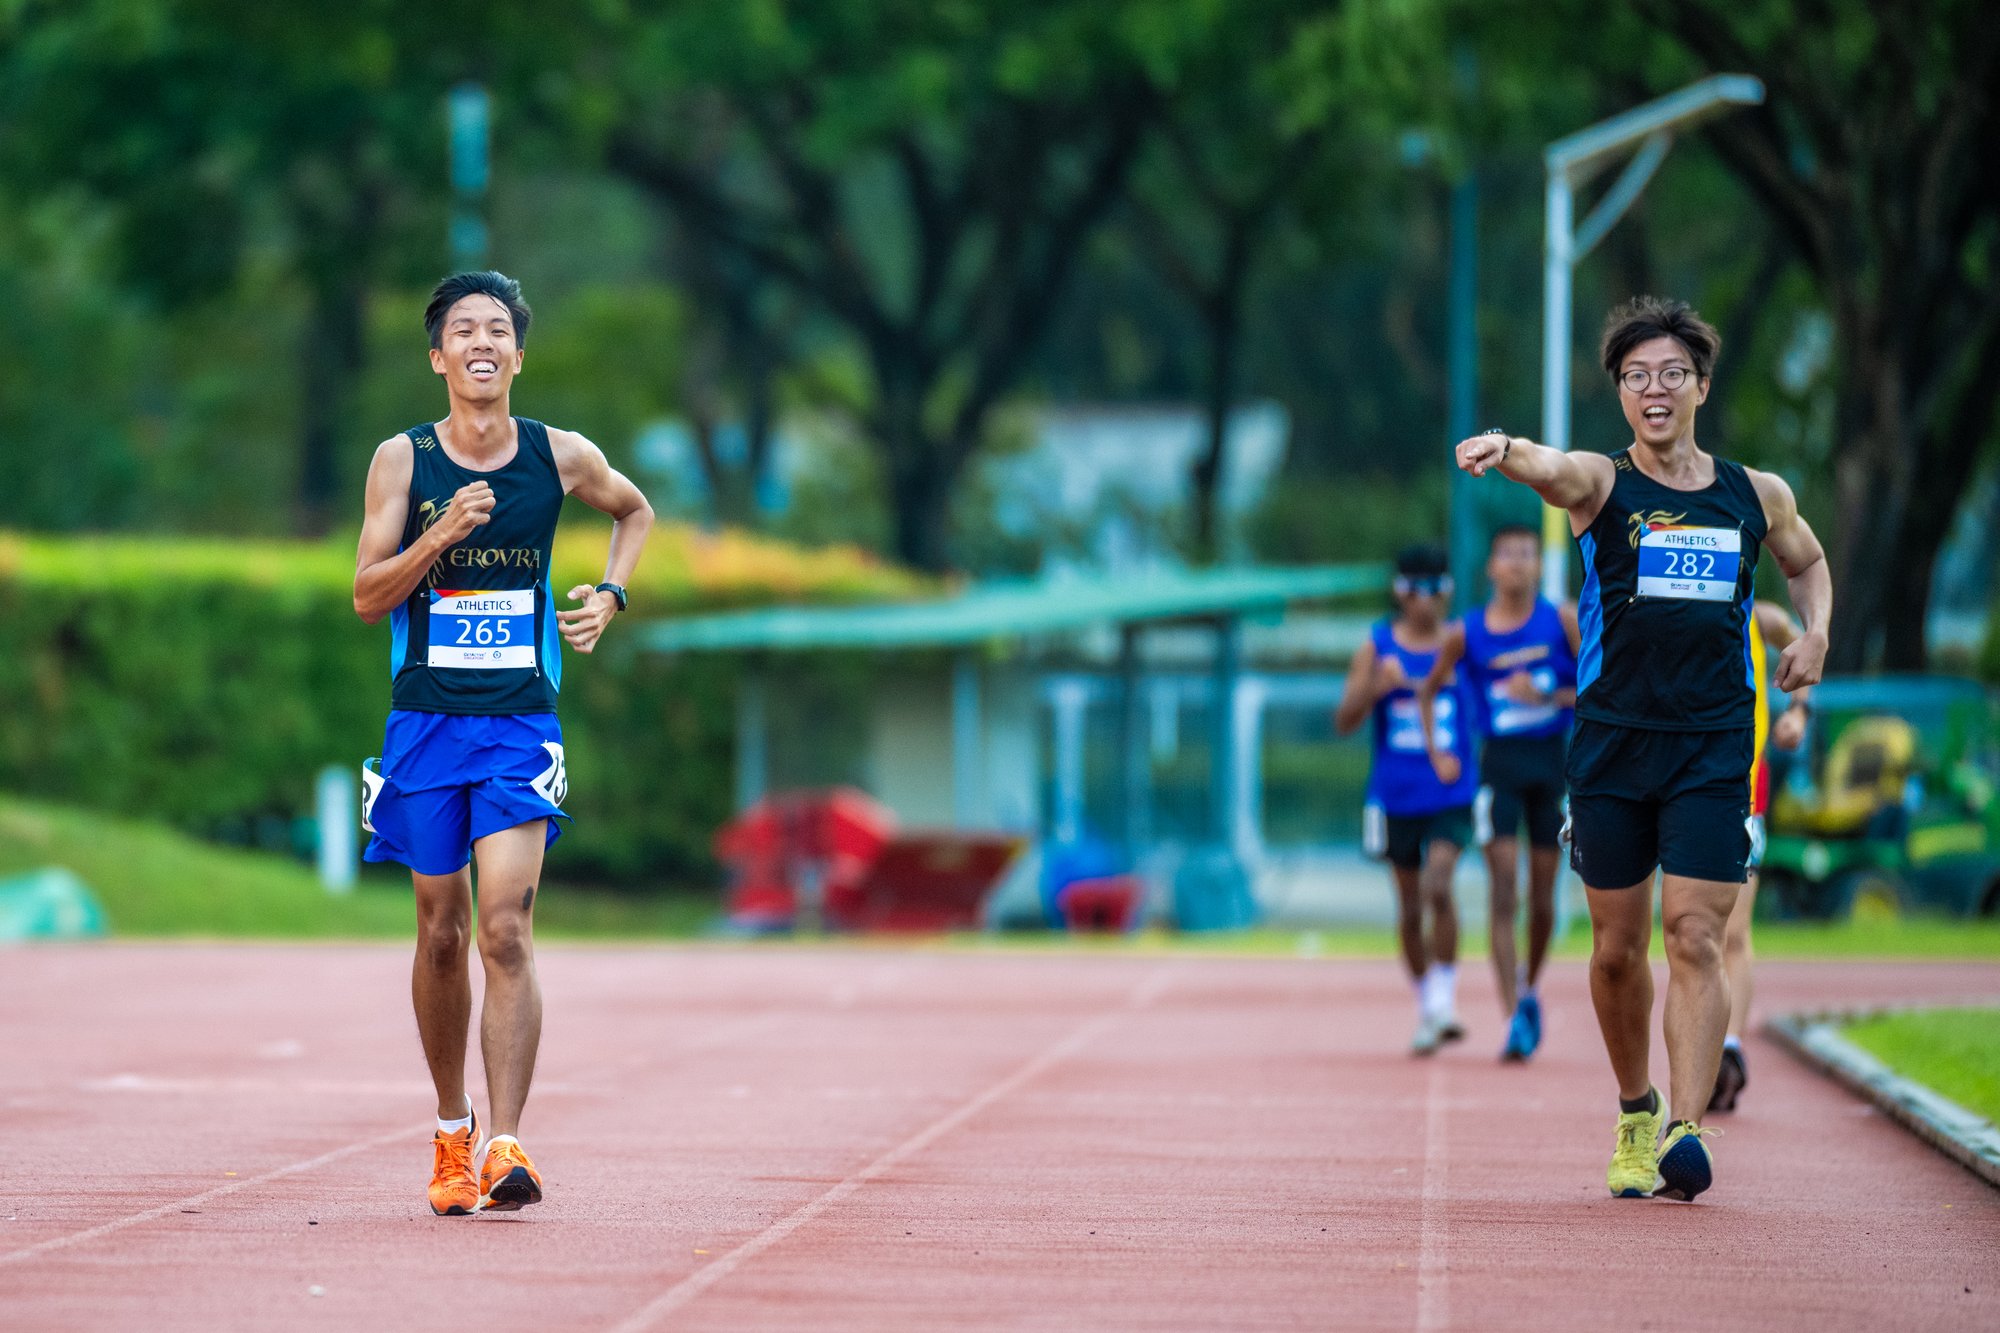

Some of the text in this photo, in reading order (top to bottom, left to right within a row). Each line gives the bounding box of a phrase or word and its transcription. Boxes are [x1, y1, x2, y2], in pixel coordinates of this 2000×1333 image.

[1665, 534, 1717, 547] ATHLETICS
[449, 547, 542, 569] EROVRA
[1663, 551, 1715, 578] 282
[455, 600, 512, 611] ATHLETICS
[455, 618, 511, 645] 265
